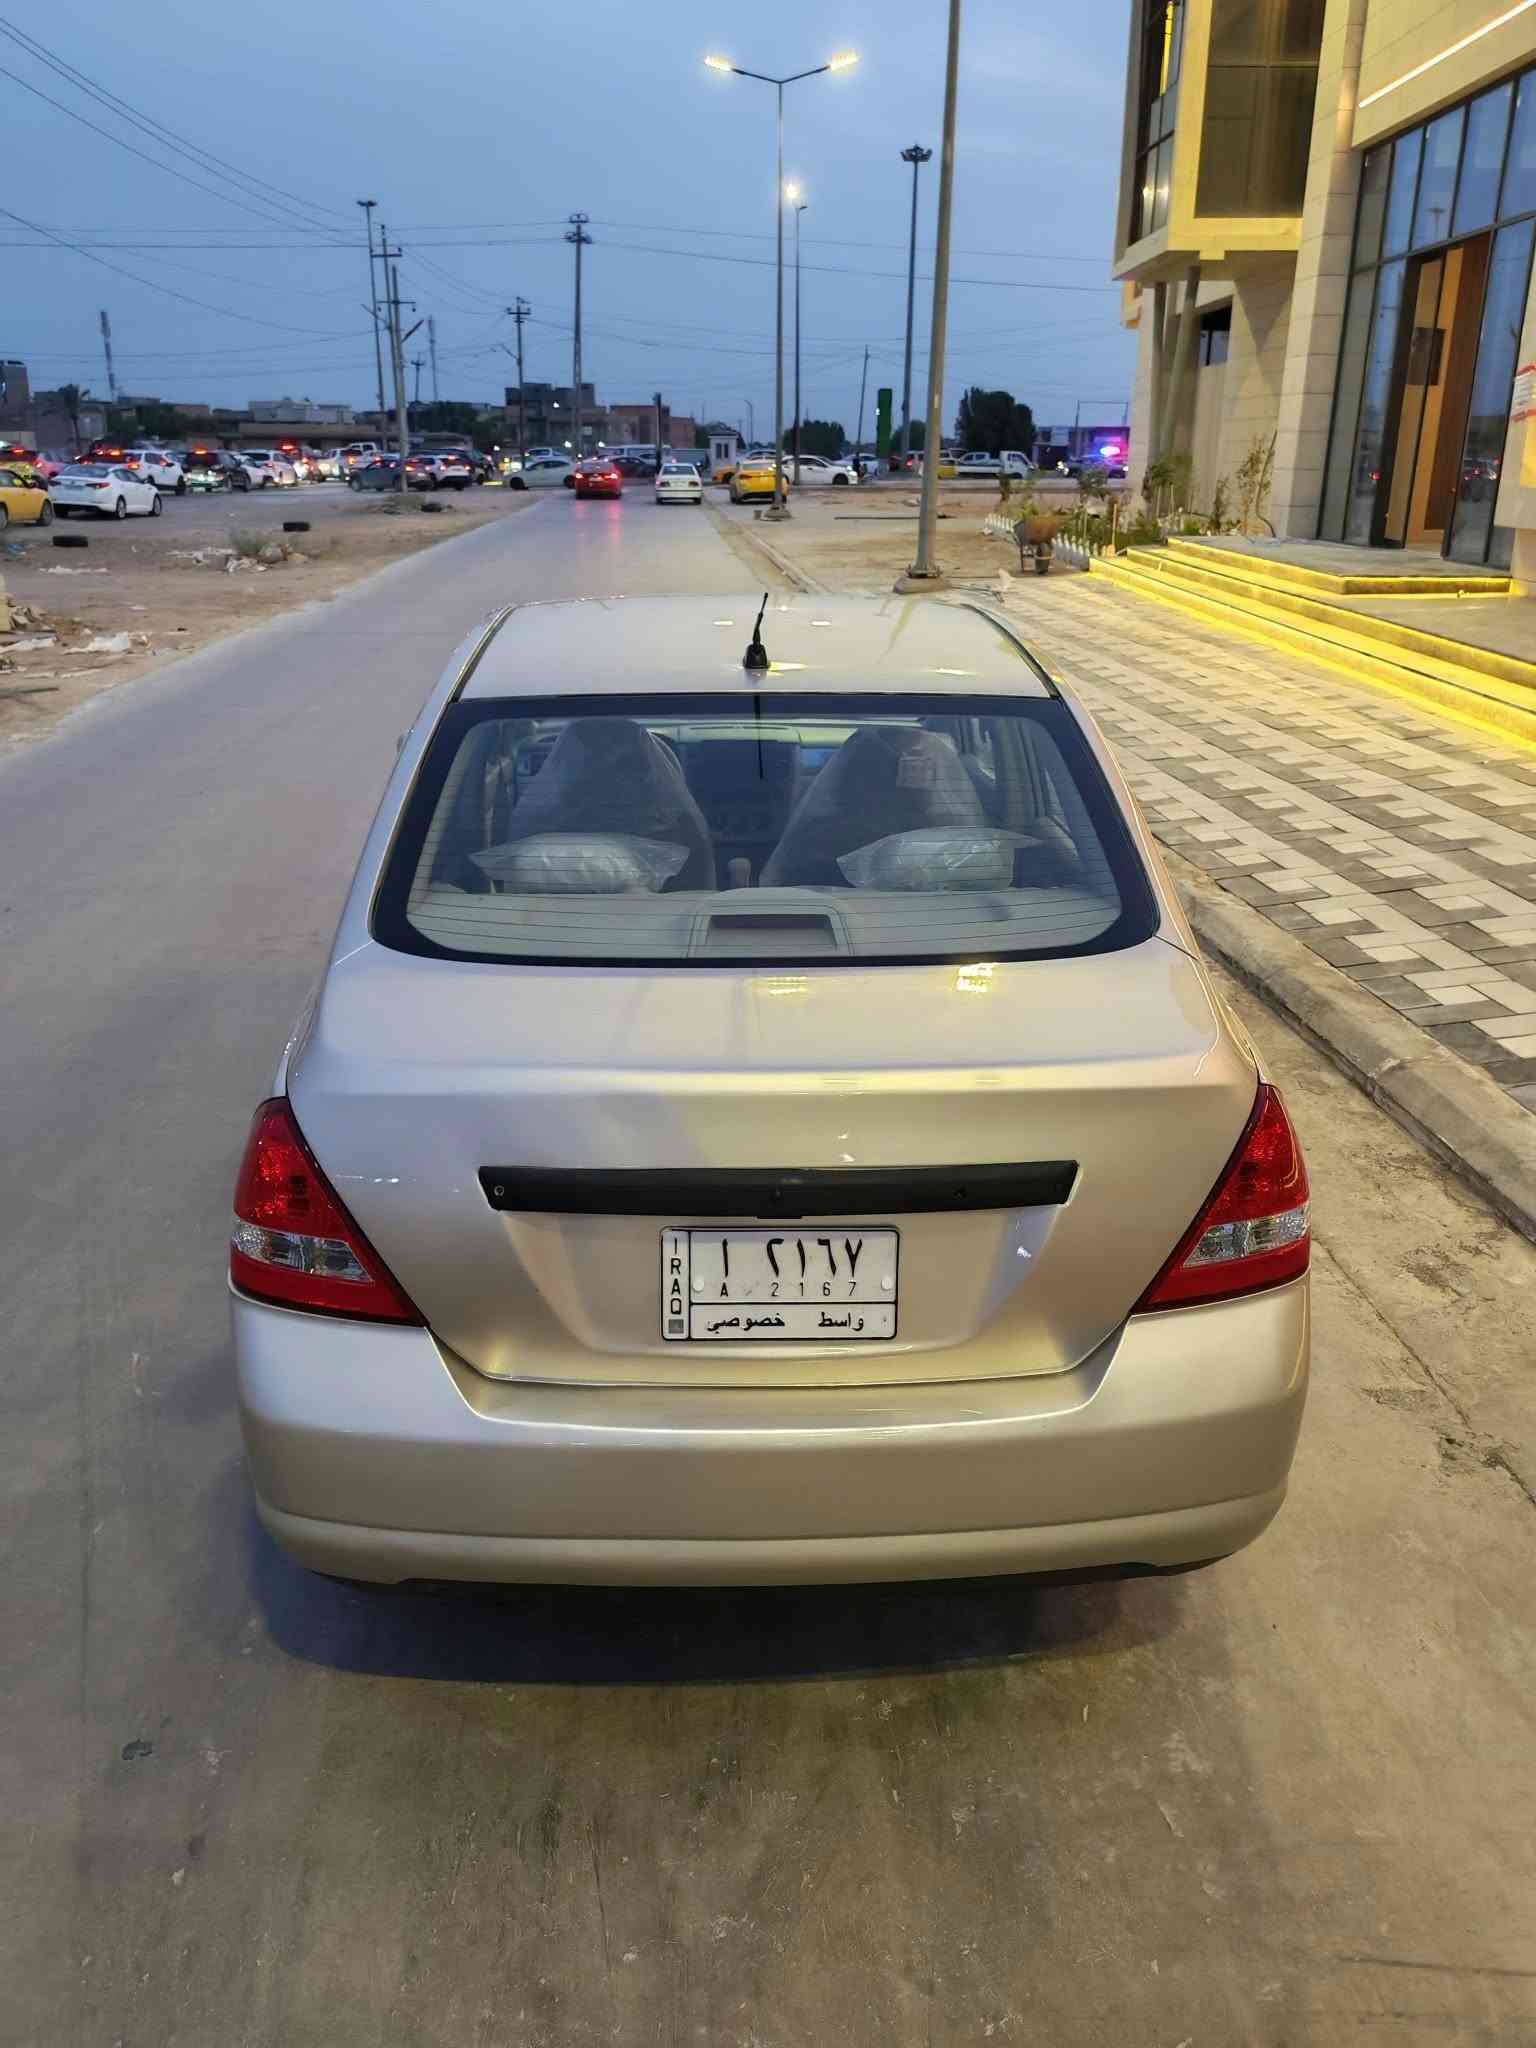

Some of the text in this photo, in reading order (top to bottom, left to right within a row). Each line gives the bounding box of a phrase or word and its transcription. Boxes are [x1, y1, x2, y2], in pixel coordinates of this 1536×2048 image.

[769, 1281, 857, 1298] 2167
[706, 1310, 865, 1335] واسط خصوصي
